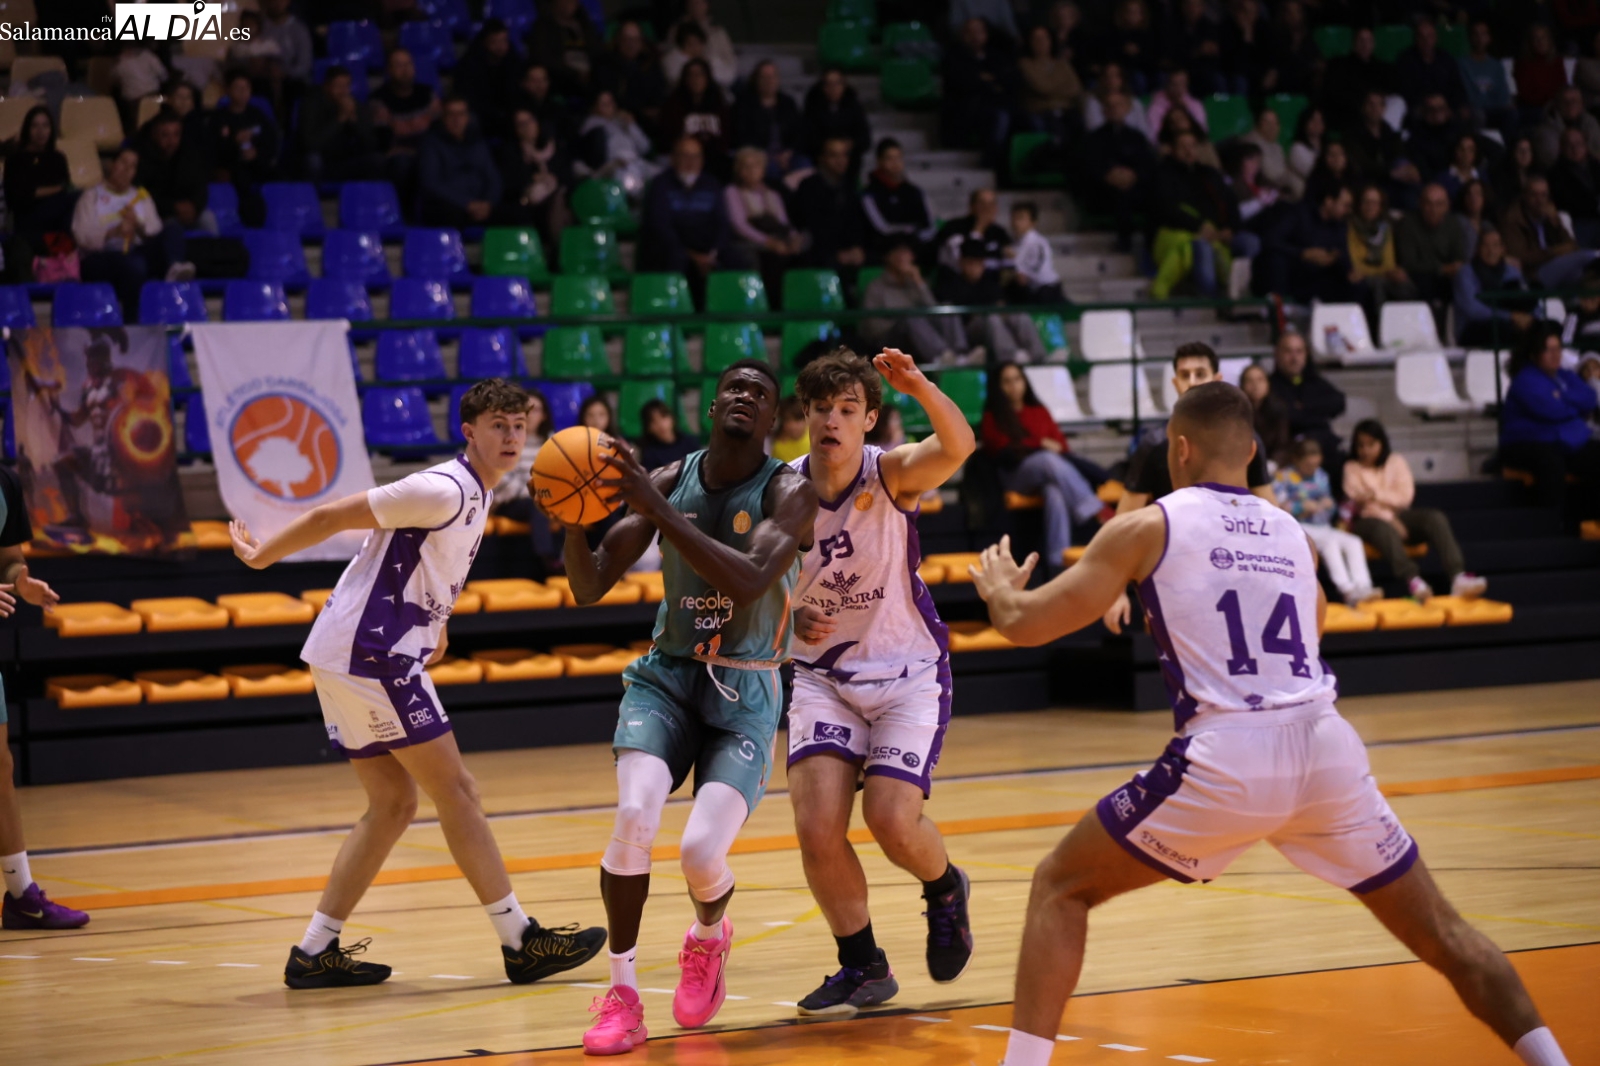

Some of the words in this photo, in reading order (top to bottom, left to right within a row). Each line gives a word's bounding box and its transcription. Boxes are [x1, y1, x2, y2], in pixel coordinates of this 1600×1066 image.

[819, 529, 854, 568] 59
[802, 594, 837, 608] CAJA
[840, 586, 887, 607] RURAL
[1216, 589, 1313, 680] 14
[408, 707, 433, 725] CBC
[1115, 788, 1137, 818] CBC
